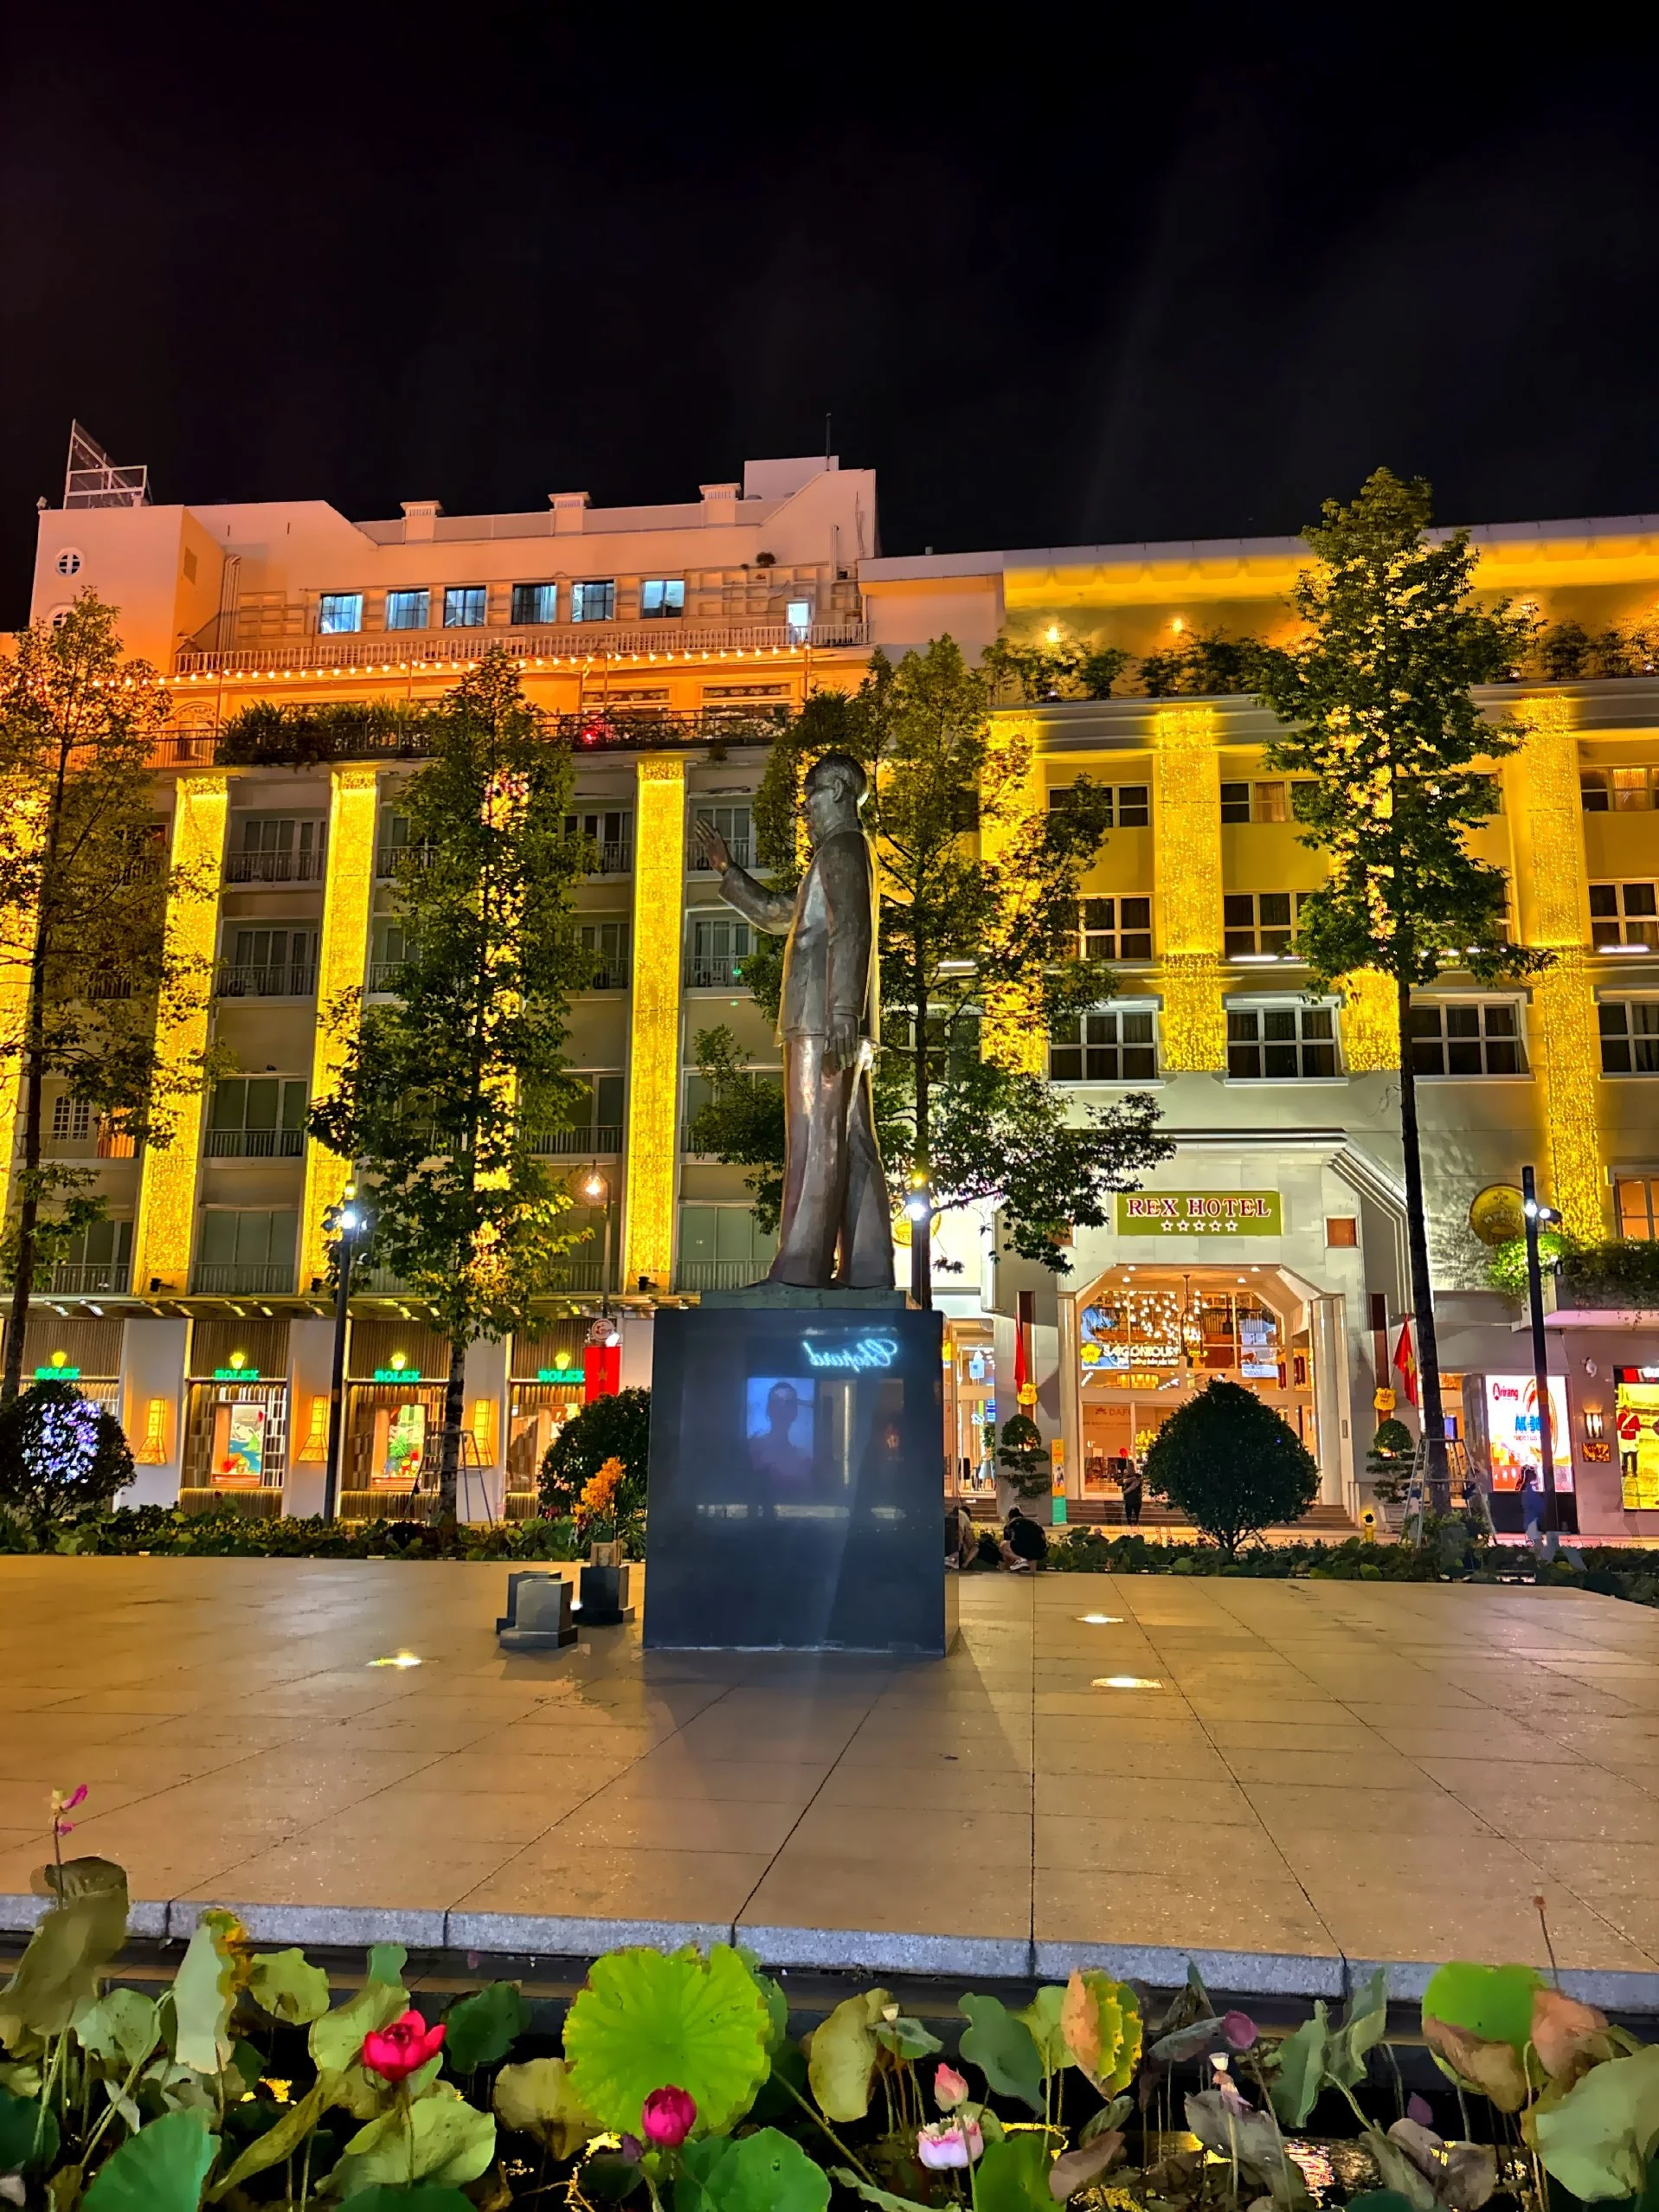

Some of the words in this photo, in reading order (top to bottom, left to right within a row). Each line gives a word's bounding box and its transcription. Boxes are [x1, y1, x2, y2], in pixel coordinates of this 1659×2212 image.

[1127, 1199, 1179, 1217] REX
[1186, 1199, 1271, 1217] HOTEL
[35, 1367, 80, 1380] ROLEX
[215, 1369, 259, 1382] ROLEX
[374, 1370, 420, 1383] ROLEX
[538, 1370, 585, 1383] ROLEX
[1493, 1383, 1518, 1400] Arirang
[1109, 1408, 1131, 1417] DAF
